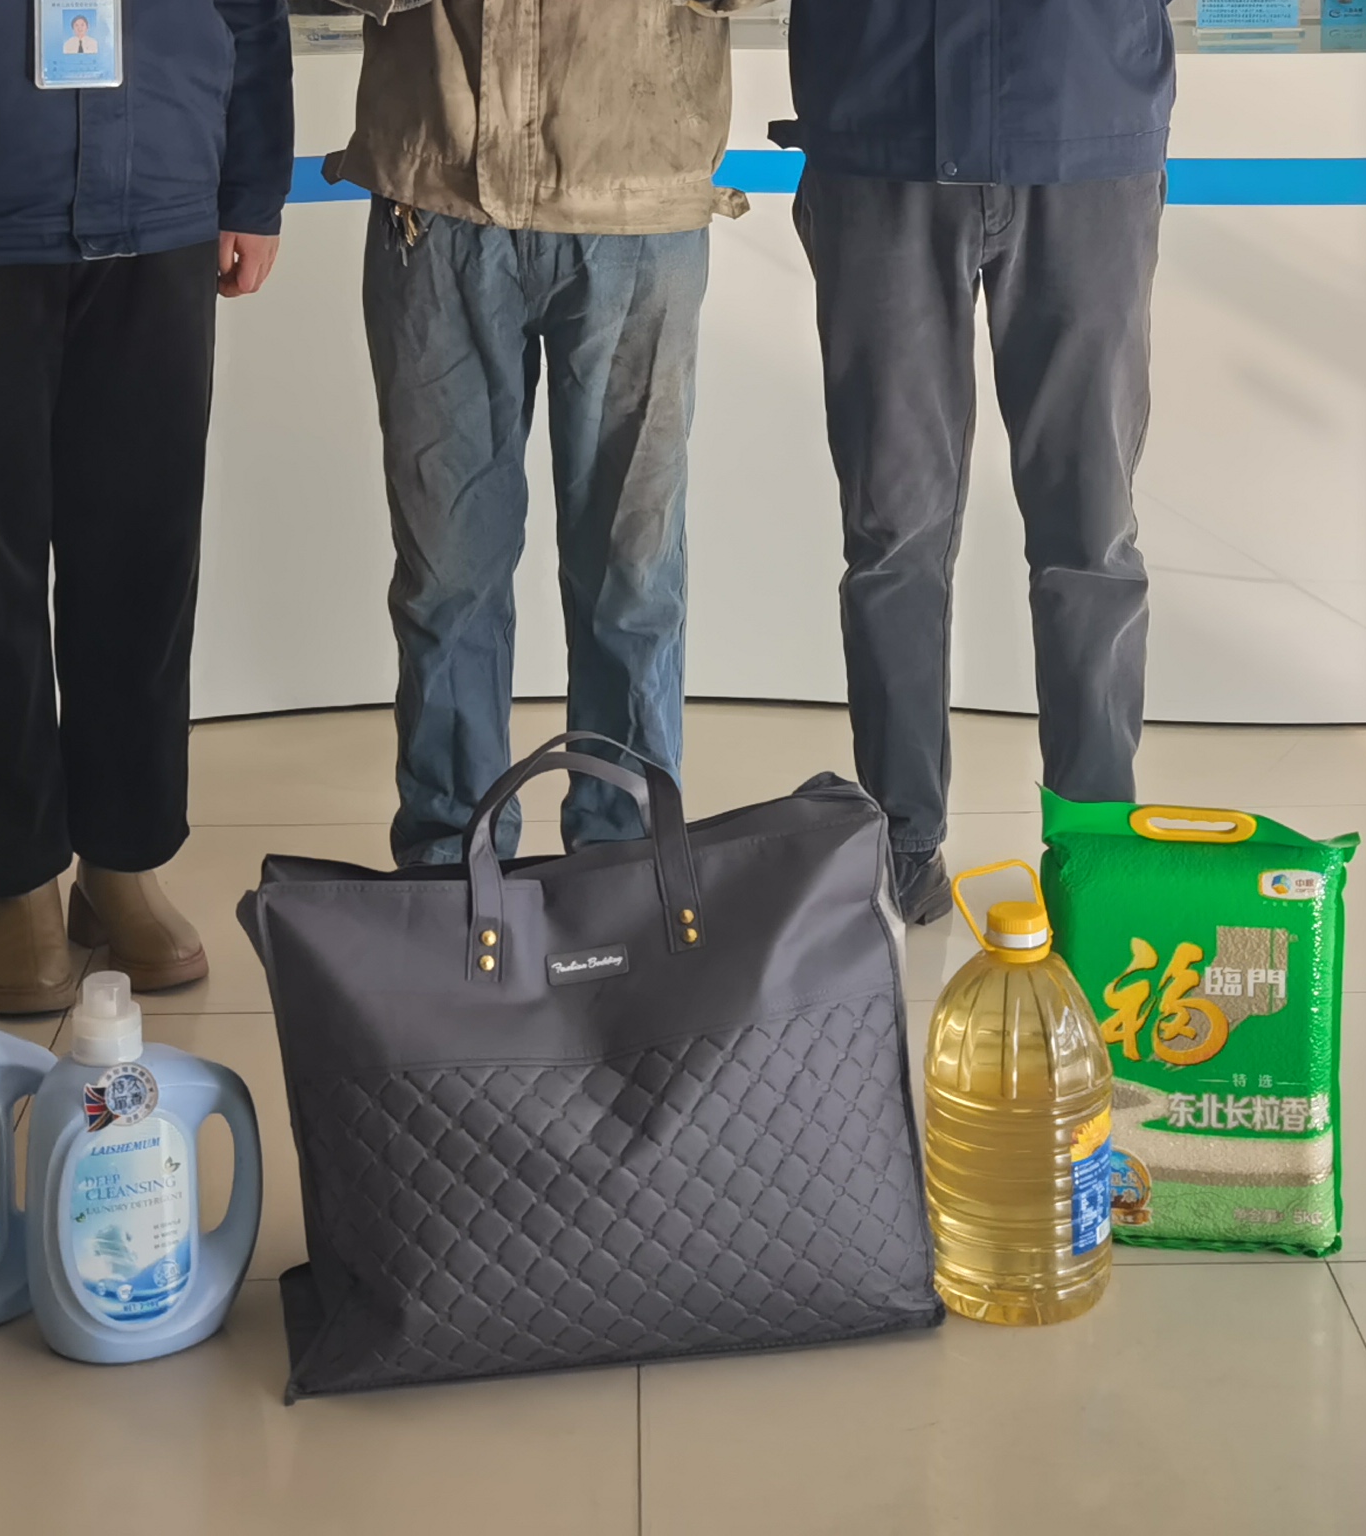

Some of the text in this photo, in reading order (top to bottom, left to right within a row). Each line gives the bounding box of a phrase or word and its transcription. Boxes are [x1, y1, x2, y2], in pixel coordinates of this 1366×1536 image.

[1100, 936, 1286, 1066] 福 臨門
[1232, 1073, 1273, 1089] 特选
[85, 1173, 121, 1188] DEEP
[86, 1175, 177, 1201] CLEANSING
